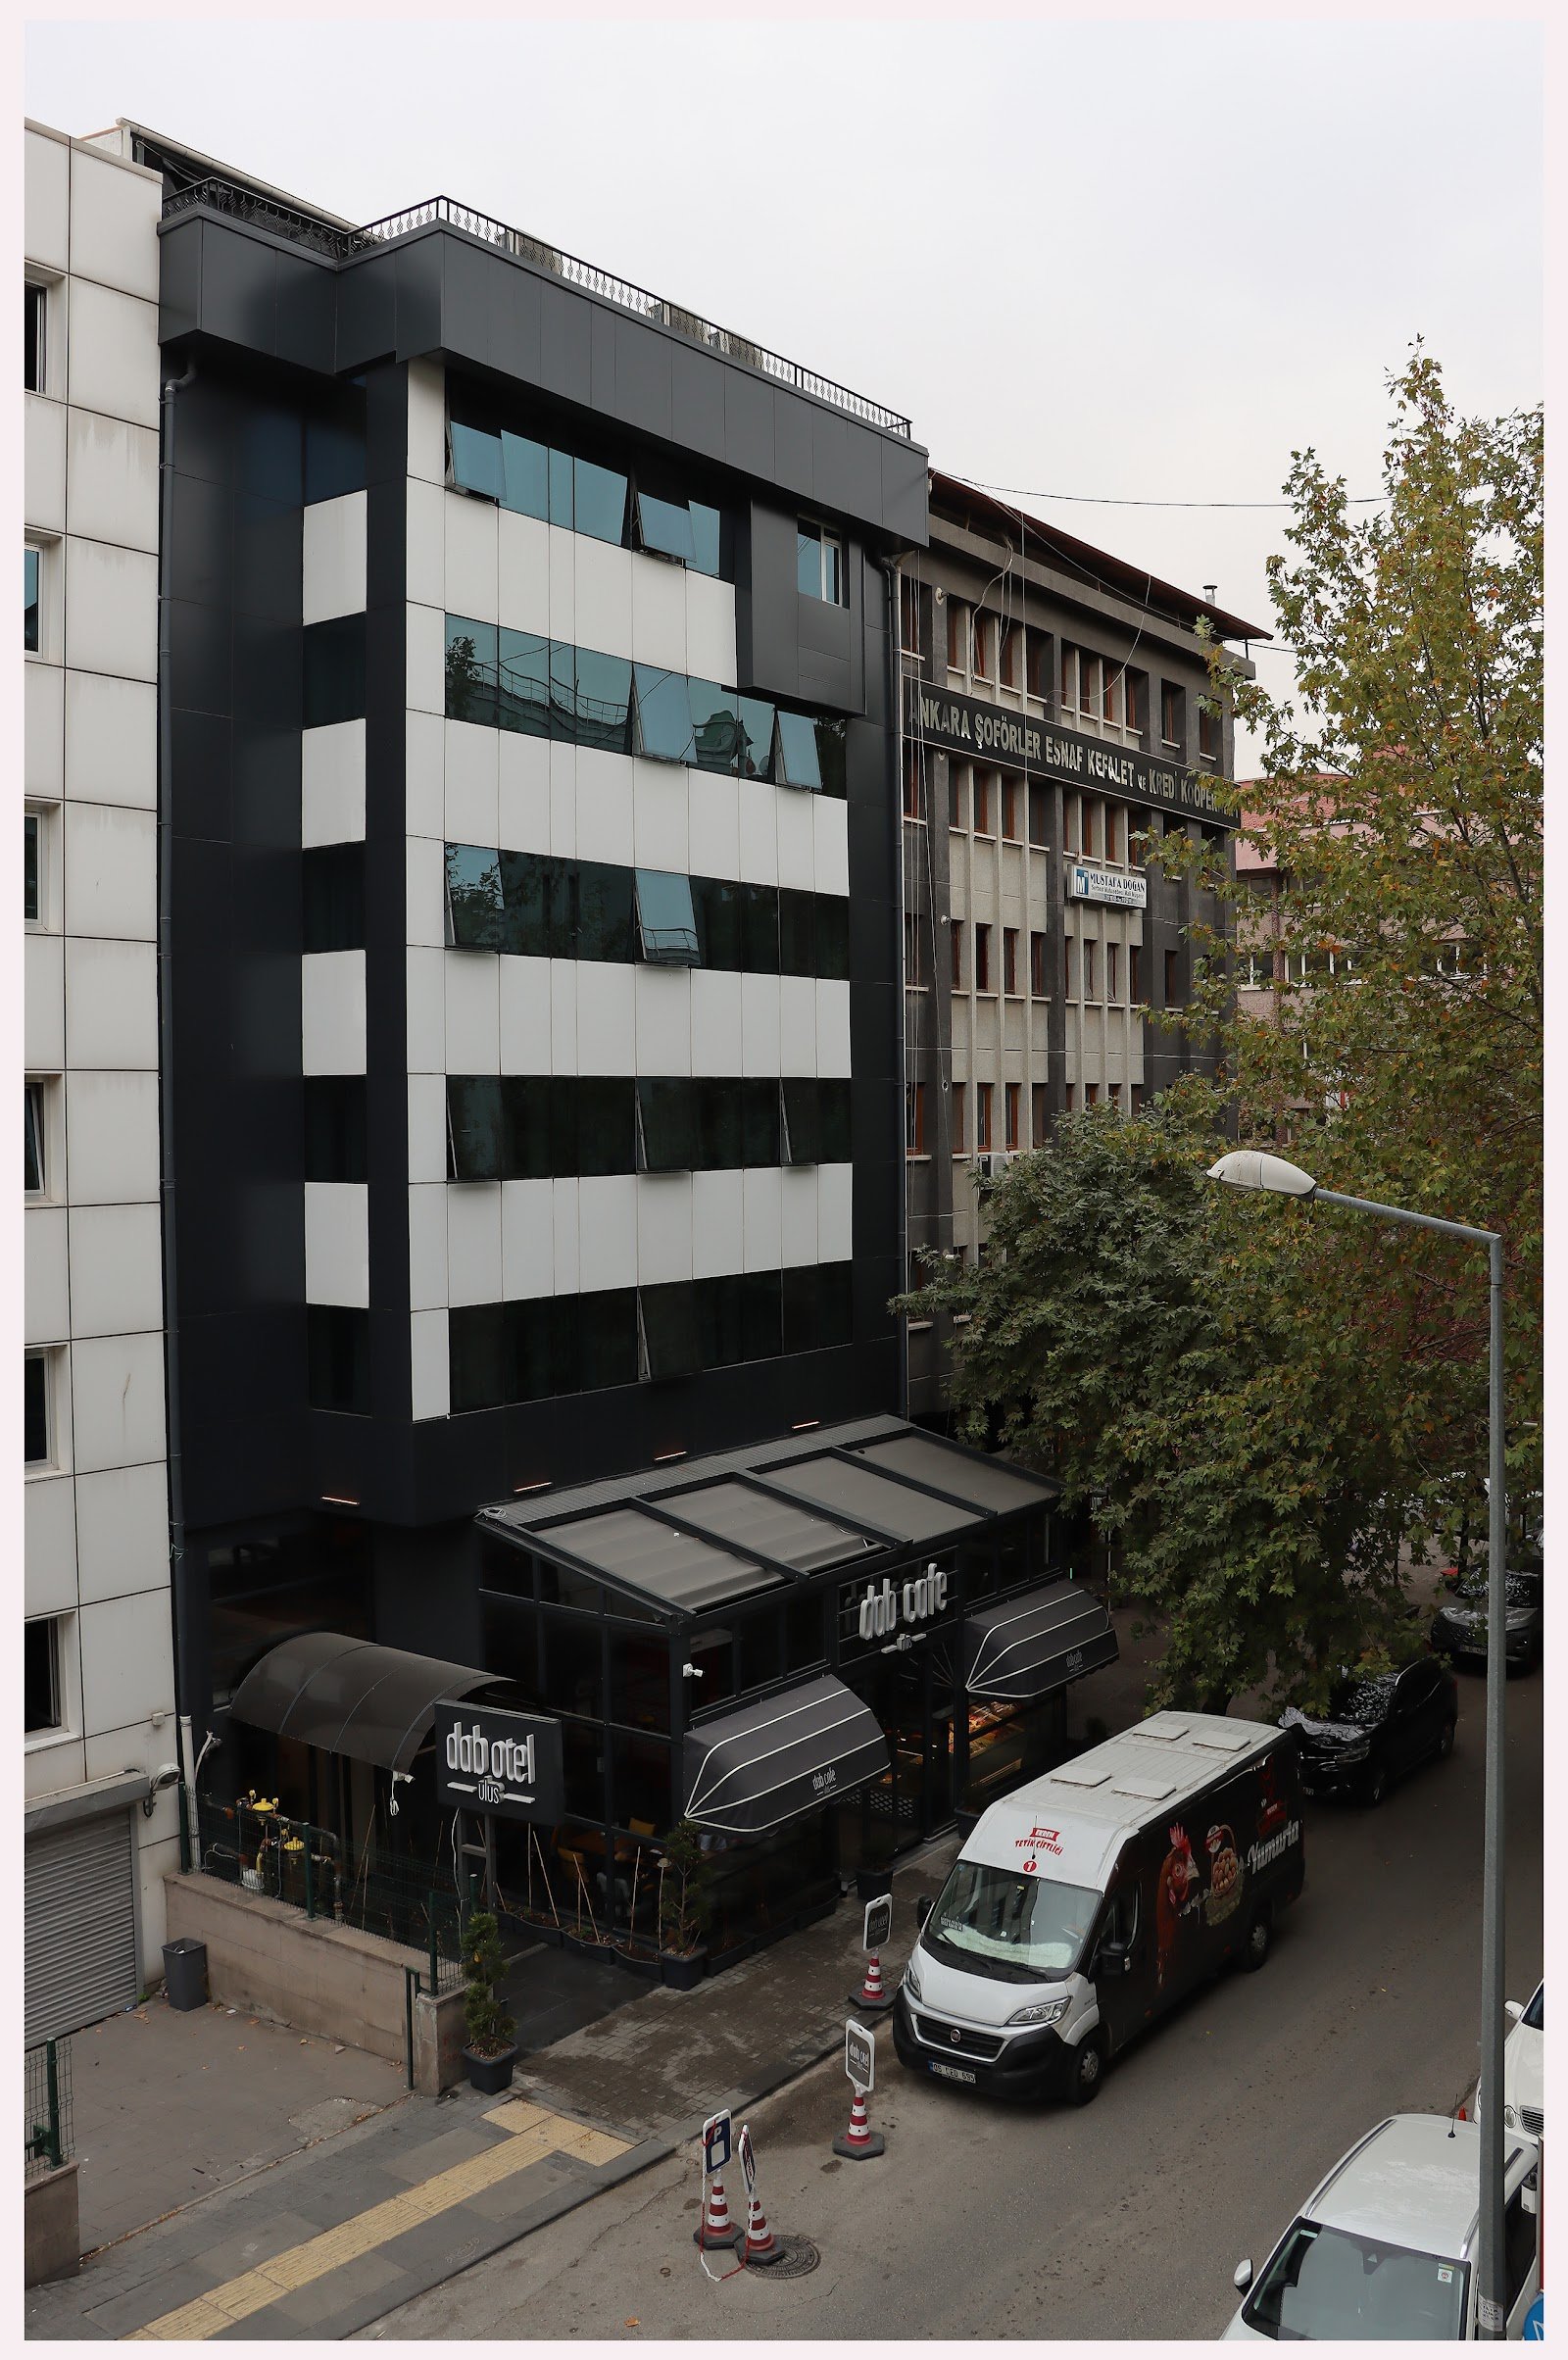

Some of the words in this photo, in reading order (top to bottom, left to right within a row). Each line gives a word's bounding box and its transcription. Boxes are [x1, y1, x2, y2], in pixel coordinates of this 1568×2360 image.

[907, 696, 972, 740] ANKARA
[974, 713, 1041, 761] ŞOFÖRLER
[1045, 735, 1083, 772] ESNAF
[1087, 748, 1135, 788] KEFALET
[1149, 767, 1177, 801] KREDİ
[1090, 872, 1122, 889] MUSTAFA
[1123, 878, 1146, 893] DOĞAN
[859, 1579, 897, 1641] dab
[903, 1563, 948, 1623] cafe
[446, 1721, 489, 1776] dab
[491, 1734, 536, 1785] otel
[477, 1775, 506, 1804] ulus
[713, 2125, 723, 2142] P
